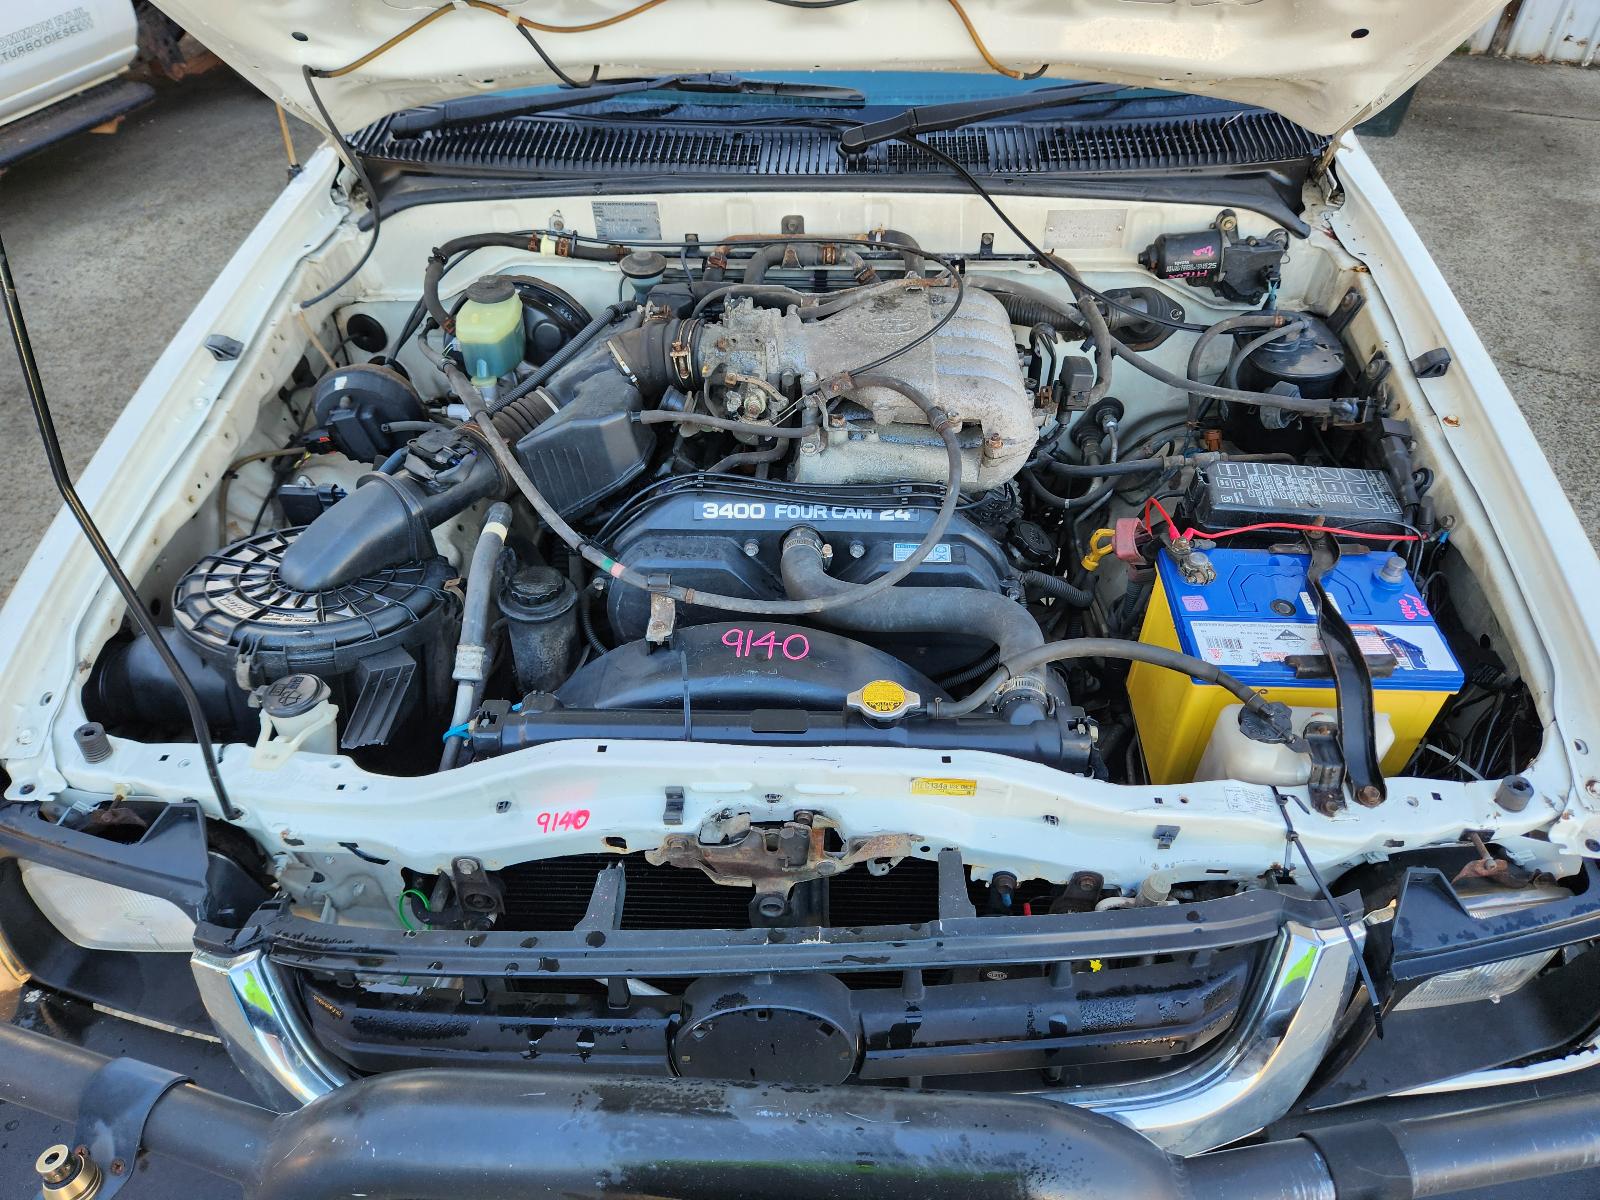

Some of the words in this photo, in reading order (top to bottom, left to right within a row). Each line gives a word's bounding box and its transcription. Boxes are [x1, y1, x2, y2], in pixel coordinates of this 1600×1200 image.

[1, 39, 42, 61] TURBO
[44, 25, 84, 45] DIESEL
[702, 502, 766, 519] 3400
[774, 504, 828, 519] FOUR
[831, 506, 873, 520] CAM
[879, 508, 911, 521] 24
[722, 628, 810, 661] 9140
[537, 809, 590, 834] 9140
